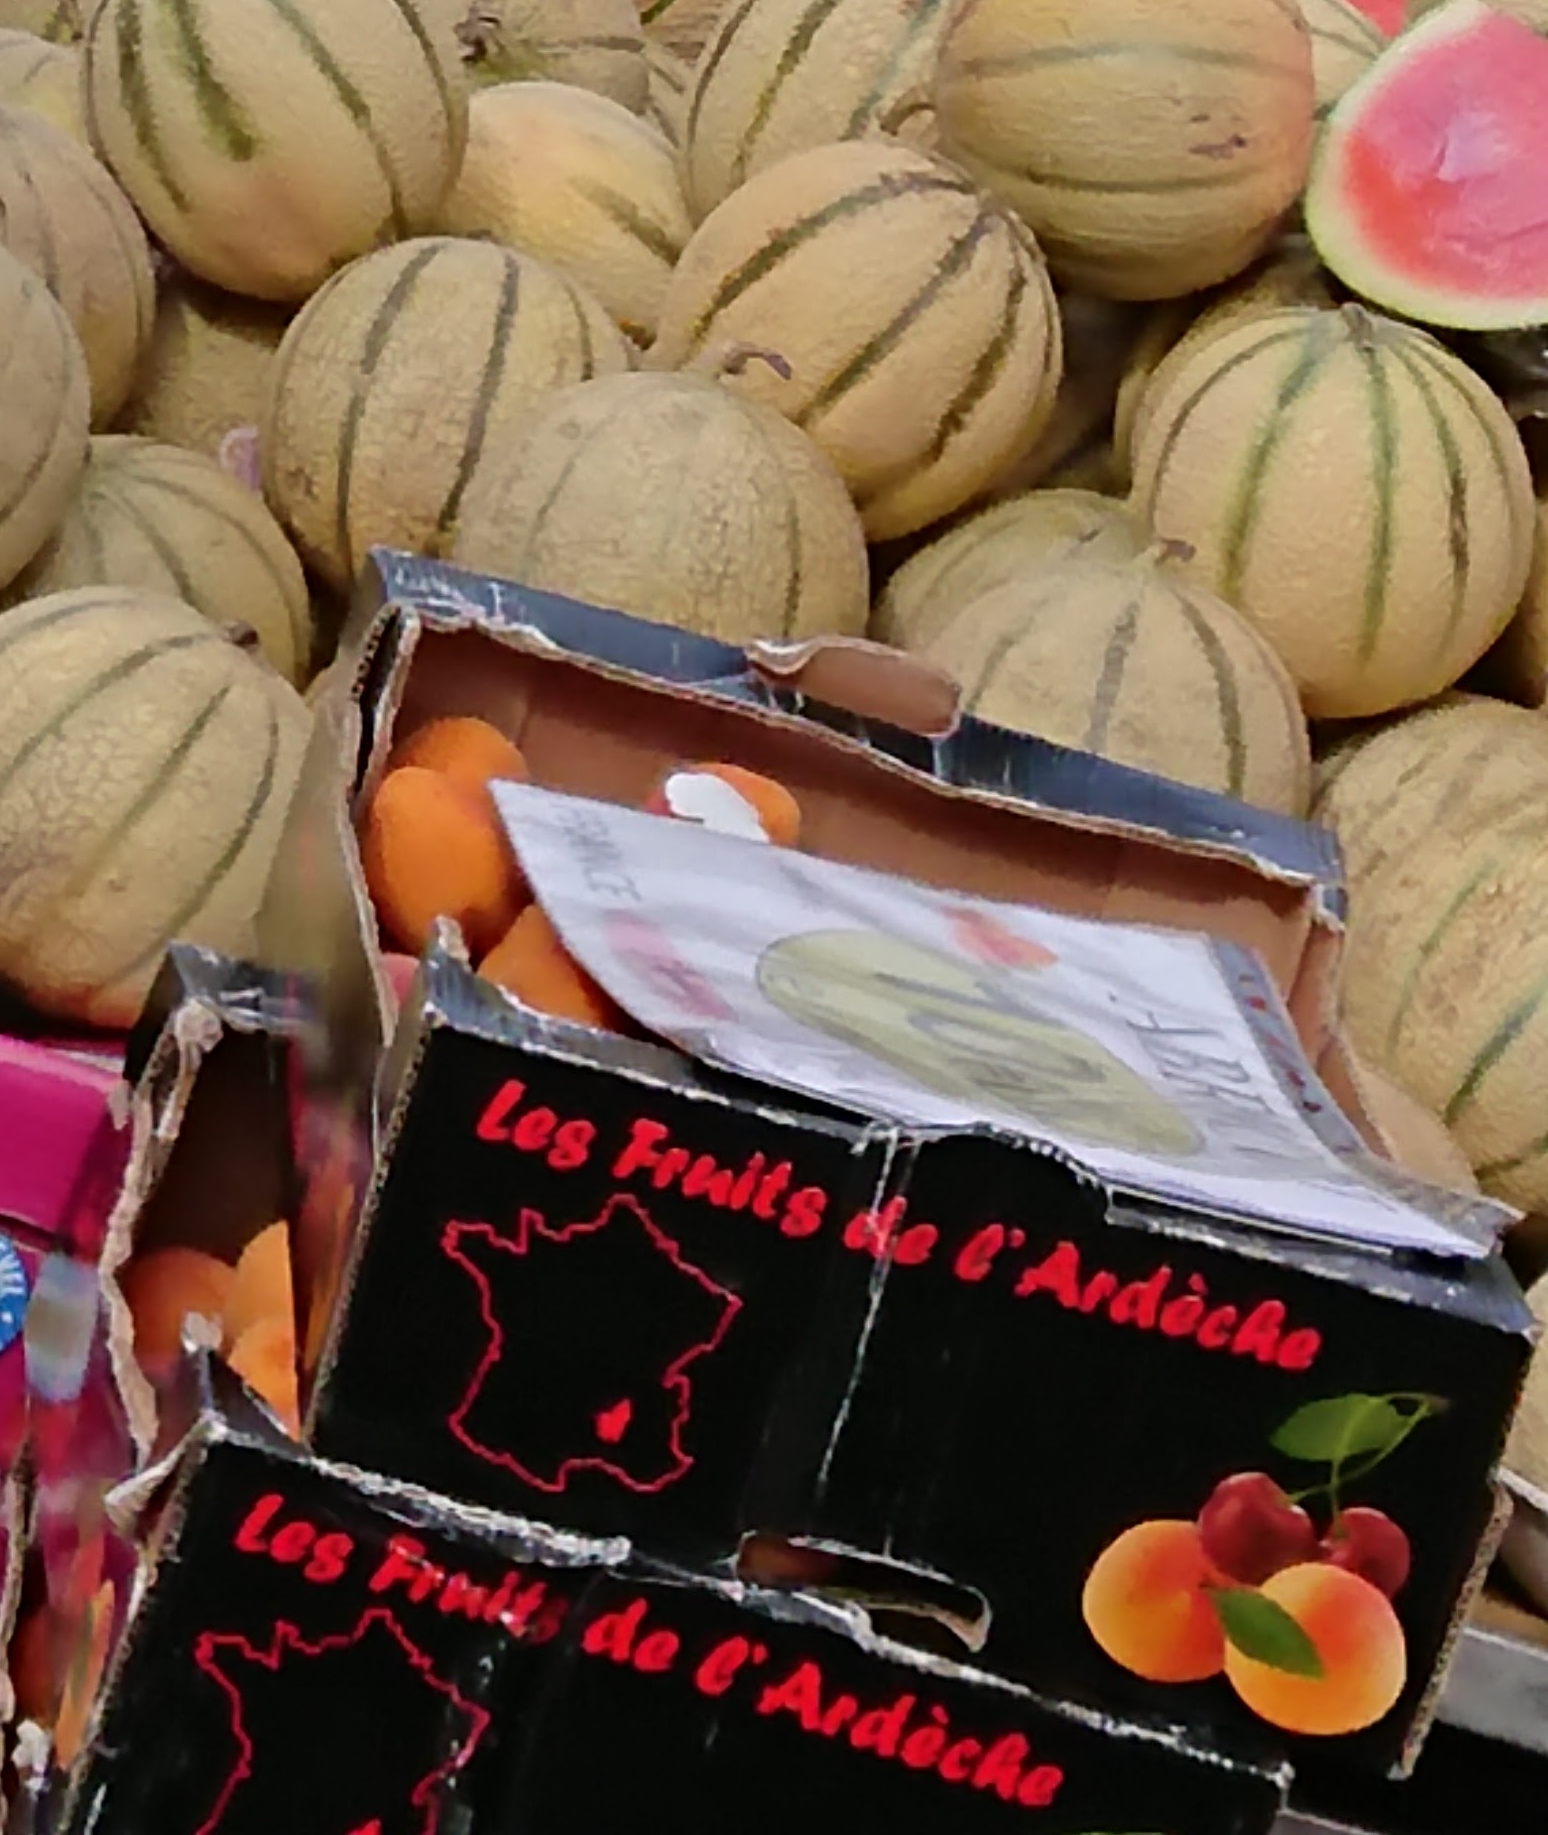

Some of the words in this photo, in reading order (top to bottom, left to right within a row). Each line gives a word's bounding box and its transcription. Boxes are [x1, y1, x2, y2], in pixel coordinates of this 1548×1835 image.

[476, 1079, 596, 1170] Les
[612, 1117, 832, 1238] Fruits
[843, 1193, 939, 1266] de
[233, 1492, 355, 1584] Les
[368, 1534, 562, 1644] Fruits
[581, 1597, 680, 1673] de
